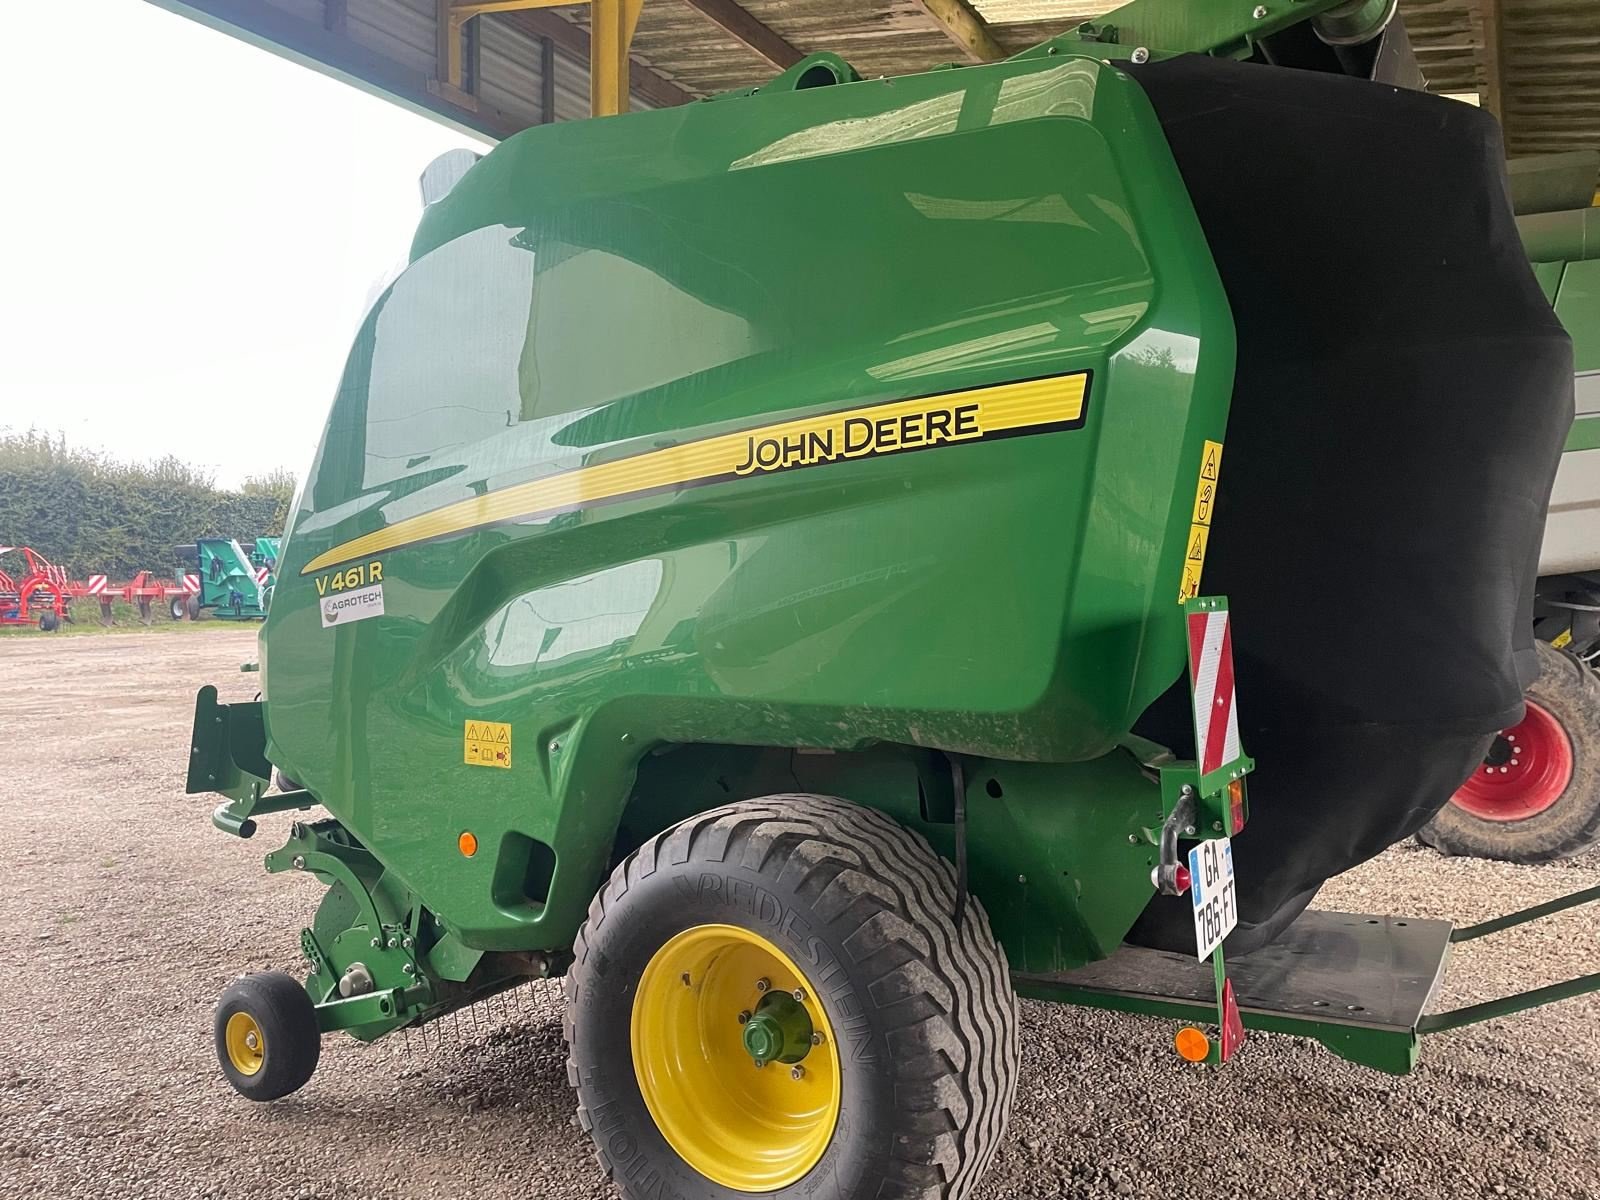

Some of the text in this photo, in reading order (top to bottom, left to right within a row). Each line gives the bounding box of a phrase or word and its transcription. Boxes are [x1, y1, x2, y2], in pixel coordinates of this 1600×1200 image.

[735, 404, 980, 471] JOHN DEERE
[315, 561, 383, 596] V 461 R
[332, 591, 382, 610] AGROTECH
[672, 872, 878, 1065] VREDESTEIN
